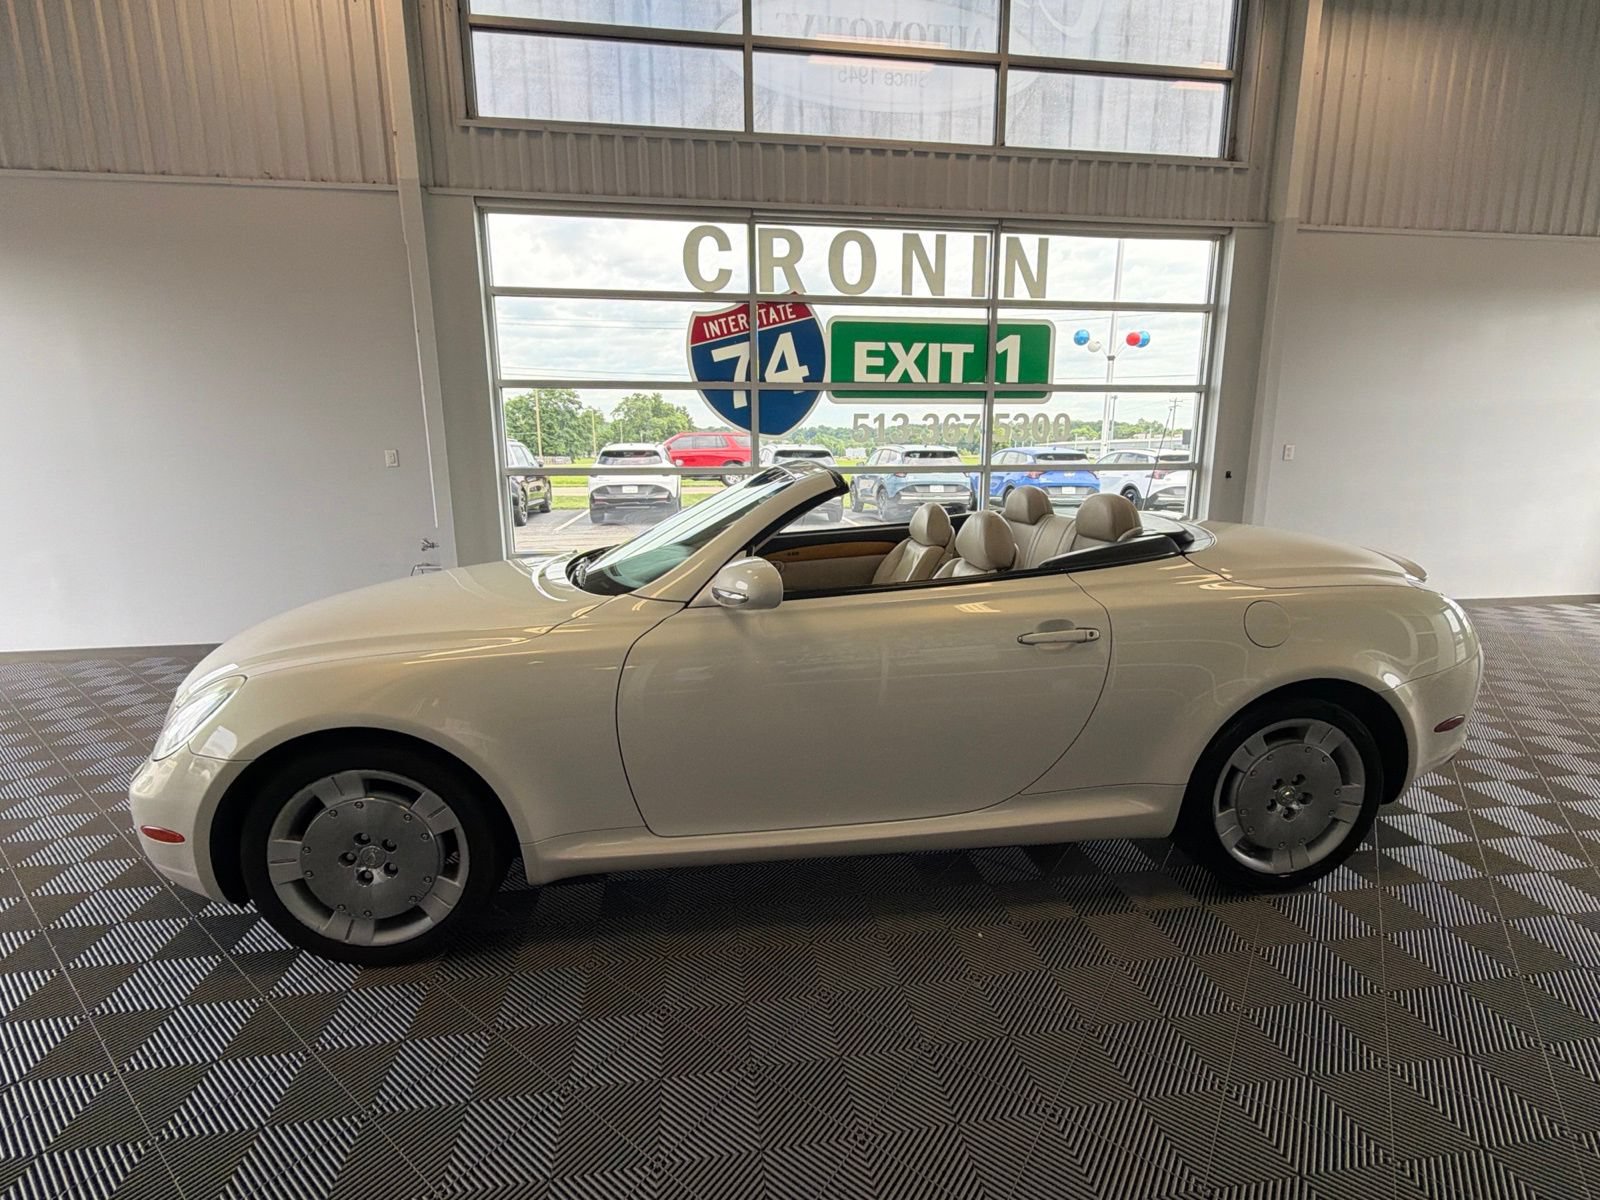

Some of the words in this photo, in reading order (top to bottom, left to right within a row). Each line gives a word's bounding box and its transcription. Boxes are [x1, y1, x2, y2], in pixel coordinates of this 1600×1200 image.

[682, 224, 1050, 299] CRONIN
[703, 302, 797, 339] INTERTATE
[711, 331, 810, 409] 74
[853, 342, 975, 383] EXIT
[995, 334, 1021, 383] 1
